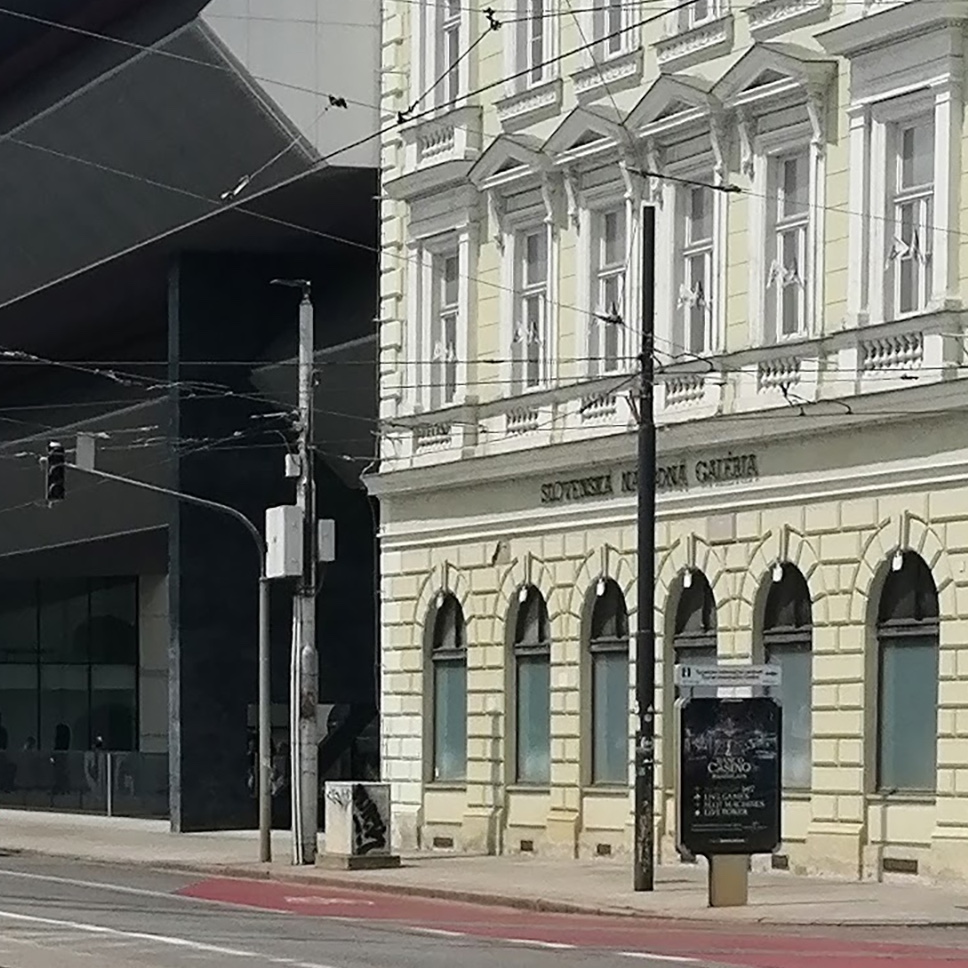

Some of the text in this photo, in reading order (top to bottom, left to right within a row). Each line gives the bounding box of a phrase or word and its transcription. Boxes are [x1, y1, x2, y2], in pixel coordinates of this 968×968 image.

[621, 459, 688, 492] NÁDNÁ
[695, 451, 759, 483] GALÉRIA
[707, 761, 752, 773] CASINO
